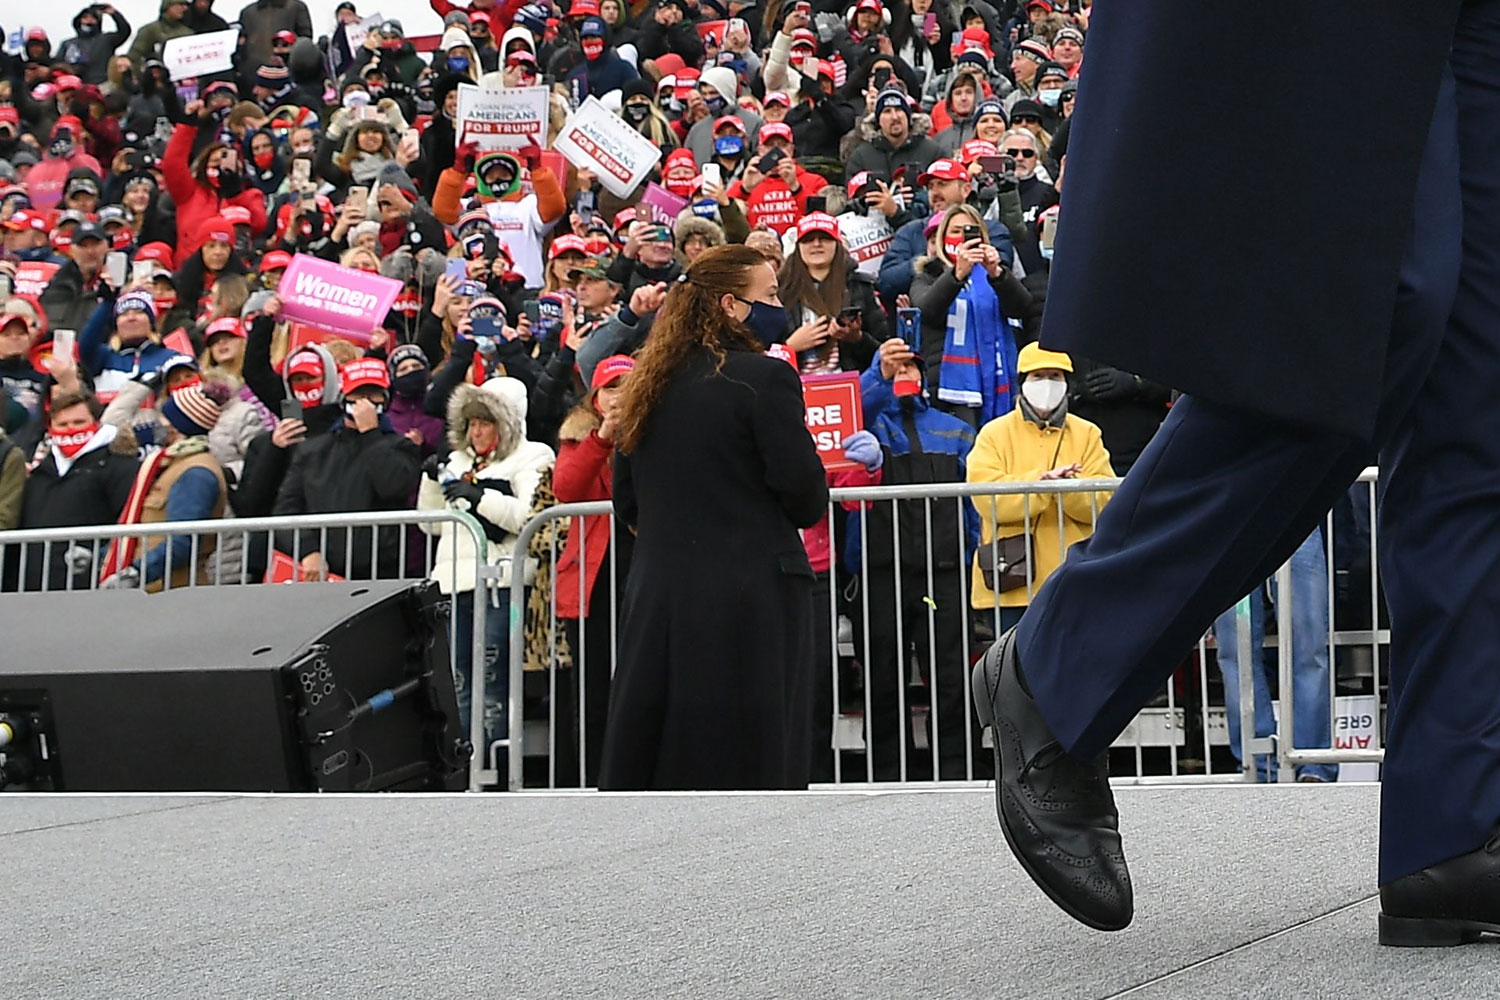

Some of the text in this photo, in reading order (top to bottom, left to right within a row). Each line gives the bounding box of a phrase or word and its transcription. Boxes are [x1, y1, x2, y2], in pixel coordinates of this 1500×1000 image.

[467, 110, 538, 121] AMERICANS
[464, 121, 539, 134] FOR TRUMP
[571, 130, 593, 150] FOR
[593, 149, 633, 183] TRUMP
[757, 213, 796, 226] GREAT
[295, 272, 378, 310] Women
[803, 404, 842, 426] RE
[1334, 715, 1373, 730] GRE
